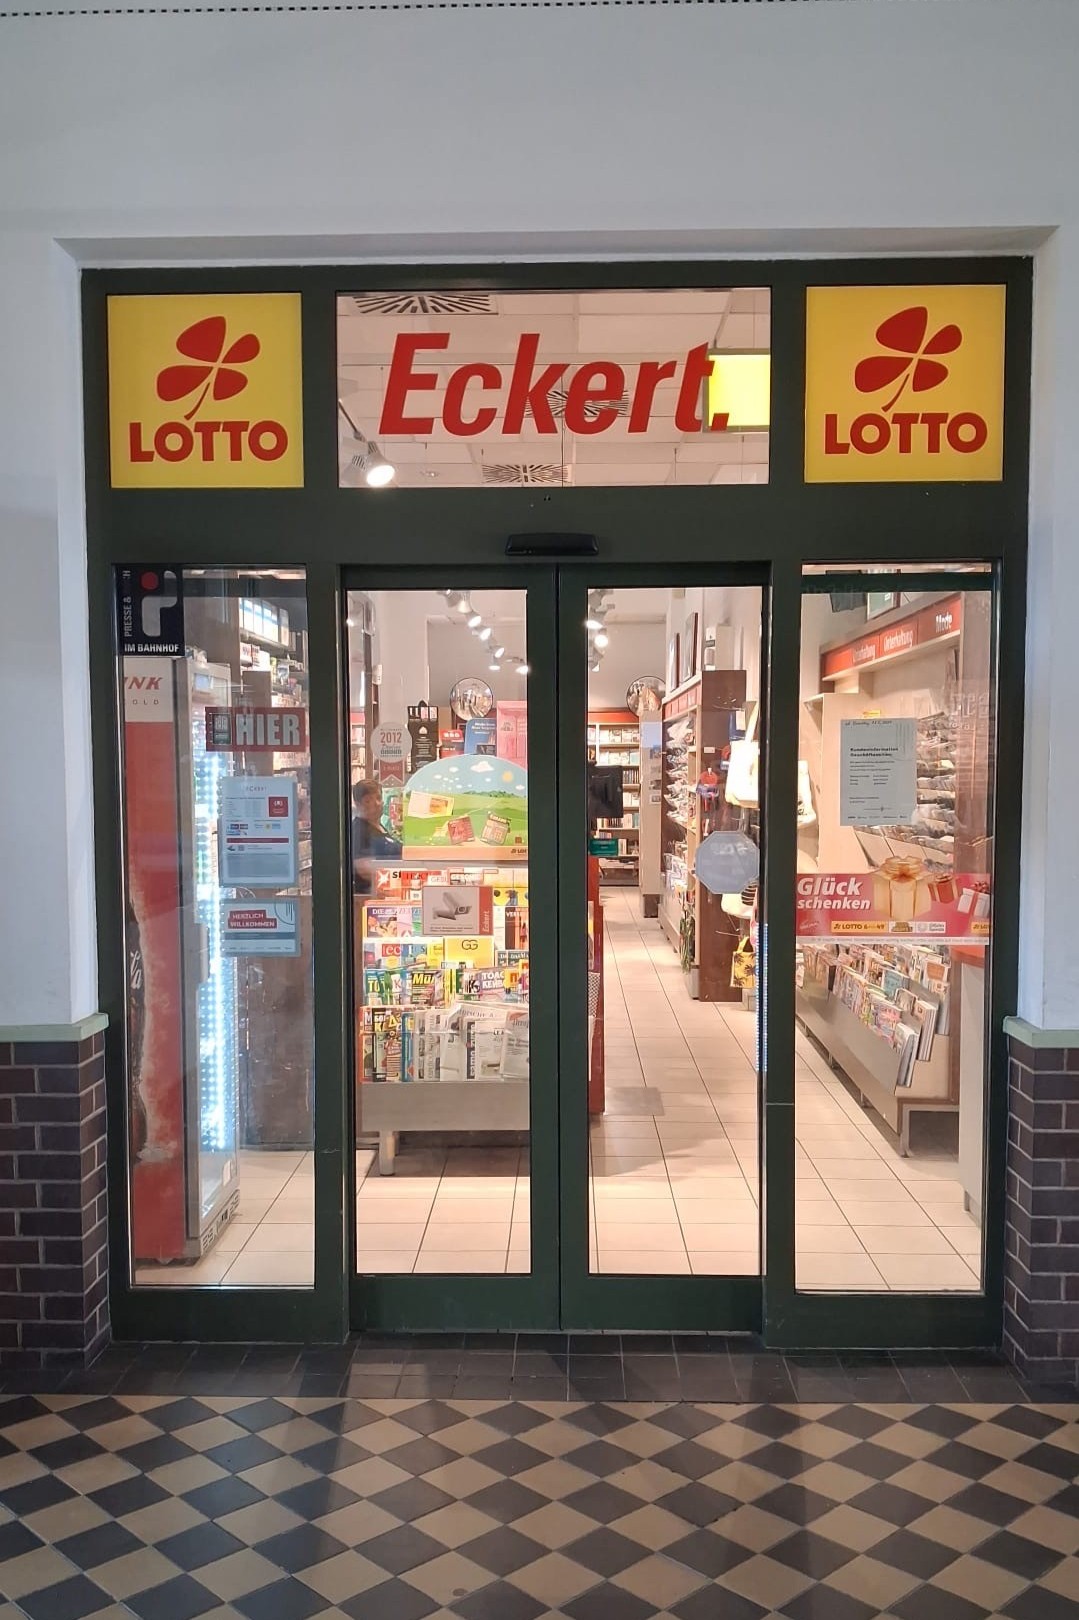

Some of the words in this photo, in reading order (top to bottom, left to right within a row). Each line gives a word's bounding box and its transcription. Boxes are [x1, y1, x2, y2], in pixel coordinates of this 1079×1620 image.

[129, 420, 289, 463] LOTTO
[824, 411, 988, 455] LOTTO
[123, 605, 132, 637] PRESSE
[124, 643, 136, 653] IM
[137, 643, 180, 653] BAHNHOF
[235, 713, 300, 746] HIER
[380, 731, 402, 743] 2012
[797, 877, 863, 896] Glück
[797, 896, 871, 910] schenken
